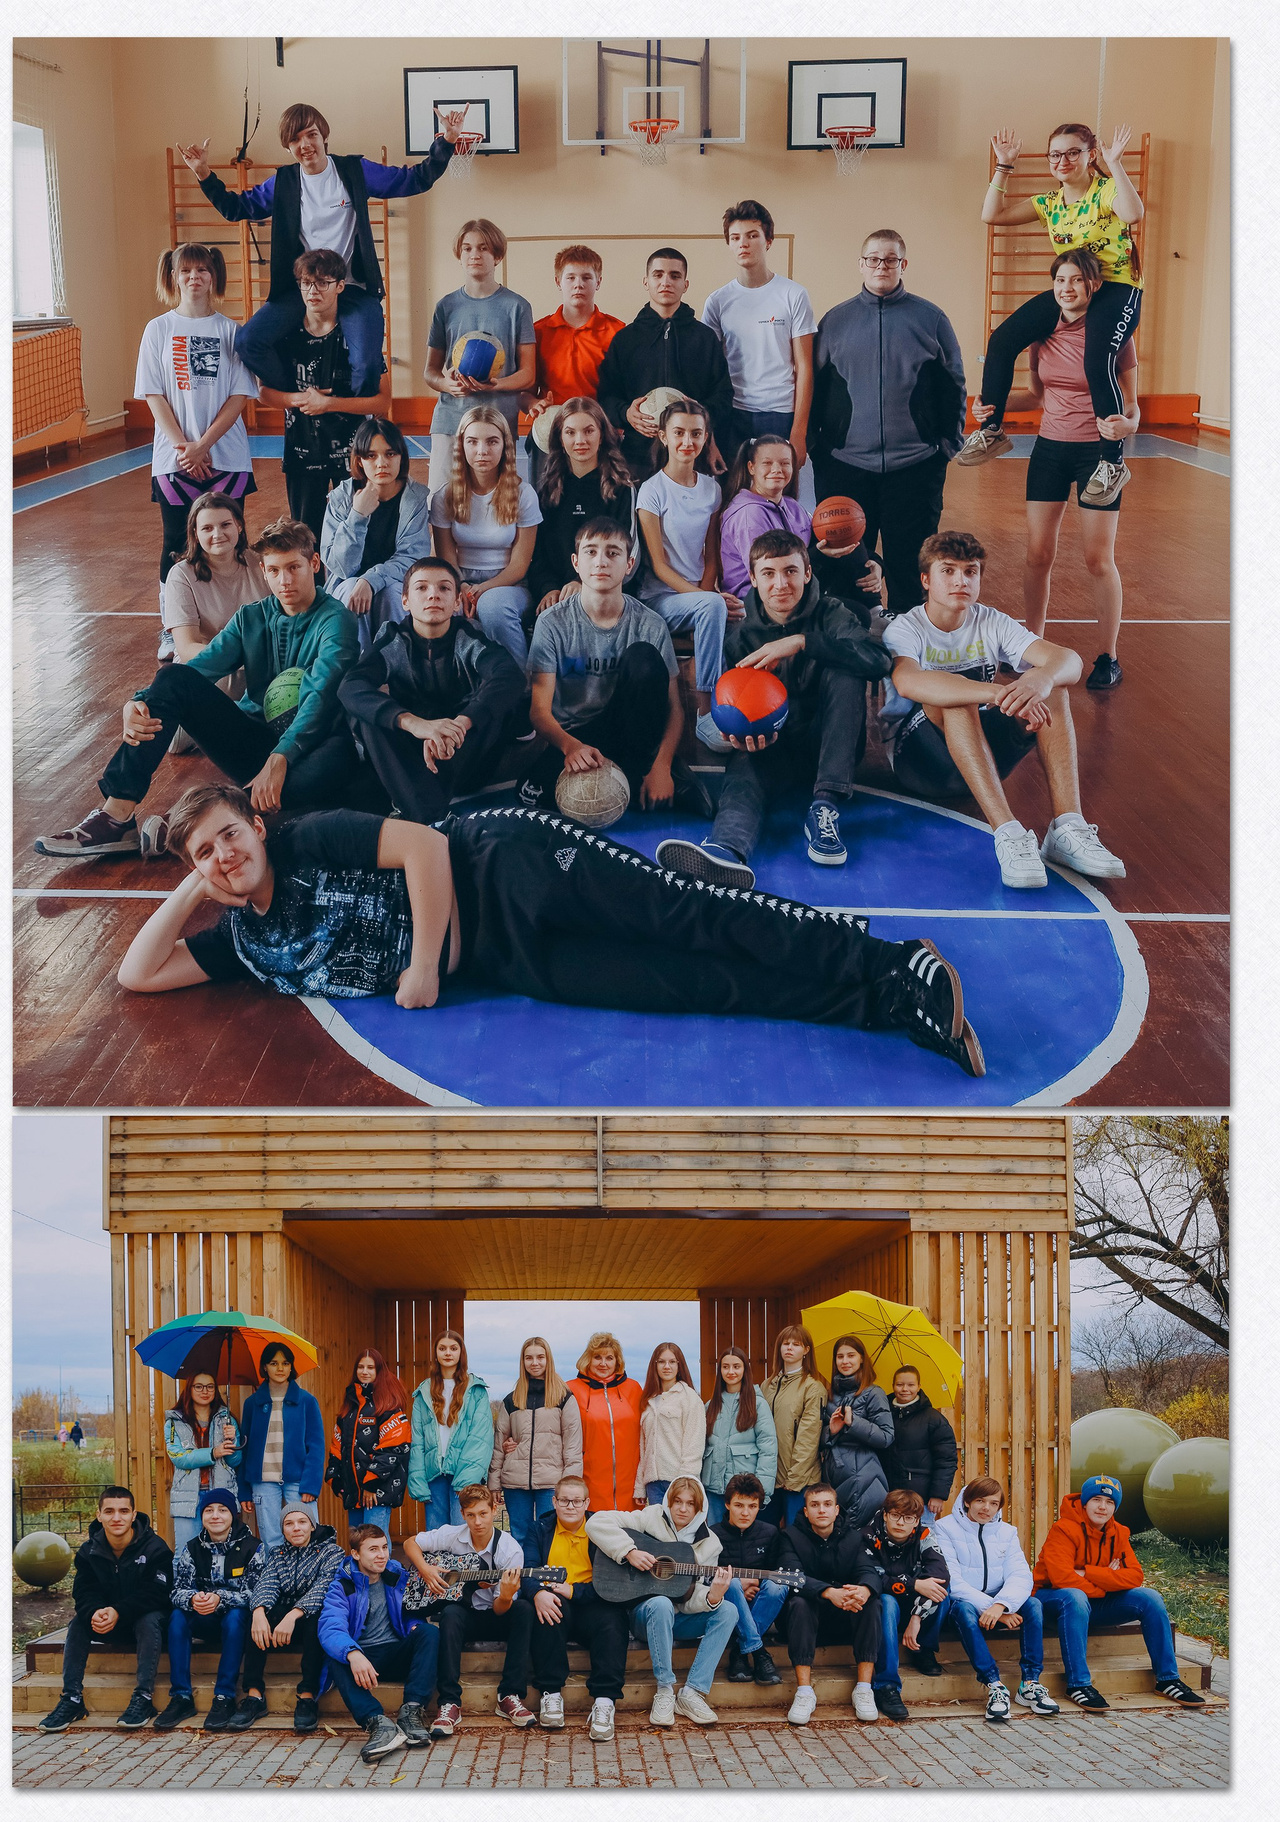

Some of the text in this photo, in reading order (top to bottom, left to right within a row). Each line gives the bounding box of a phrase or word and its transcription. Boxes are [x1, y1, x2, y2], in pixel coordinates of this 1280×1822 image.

[1110, 305, 1134, 351] SPORT
[172, 335, 191, 391] SUKUNA
[819, 508, 851, 520] TORRES
